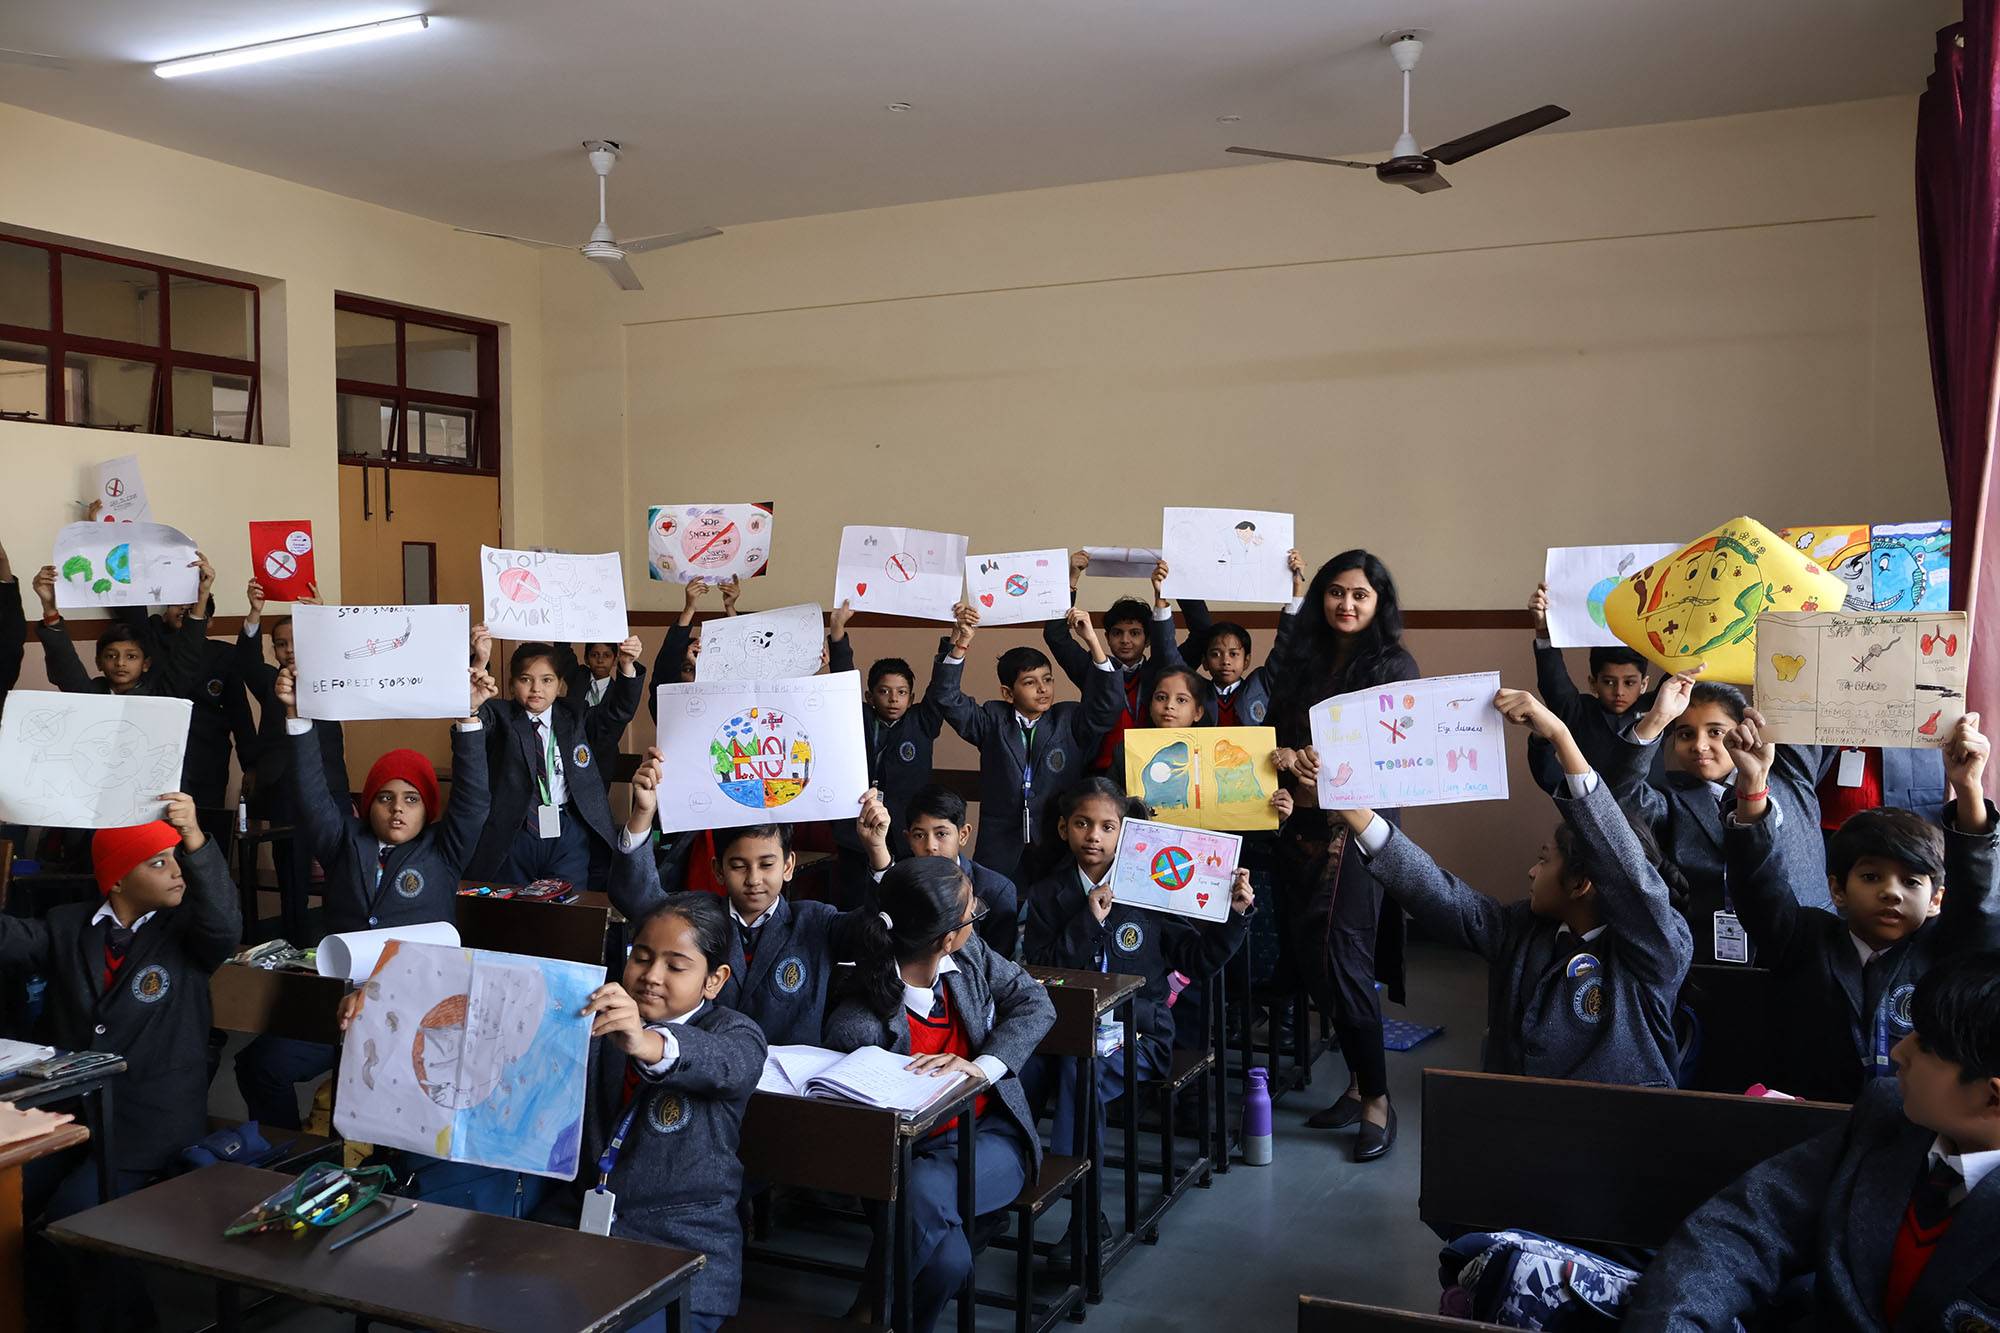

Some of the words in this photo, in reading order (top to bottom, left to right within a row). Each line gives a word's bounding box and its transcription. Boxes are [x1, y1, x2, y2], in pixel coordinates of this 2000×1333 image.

[487, 552, 547, 575] STOP
[338, 607, 368, 618] STOP
[1378, 694, 1415, 712] NO
[1374, 756, 1434, 771] TOBBACO
